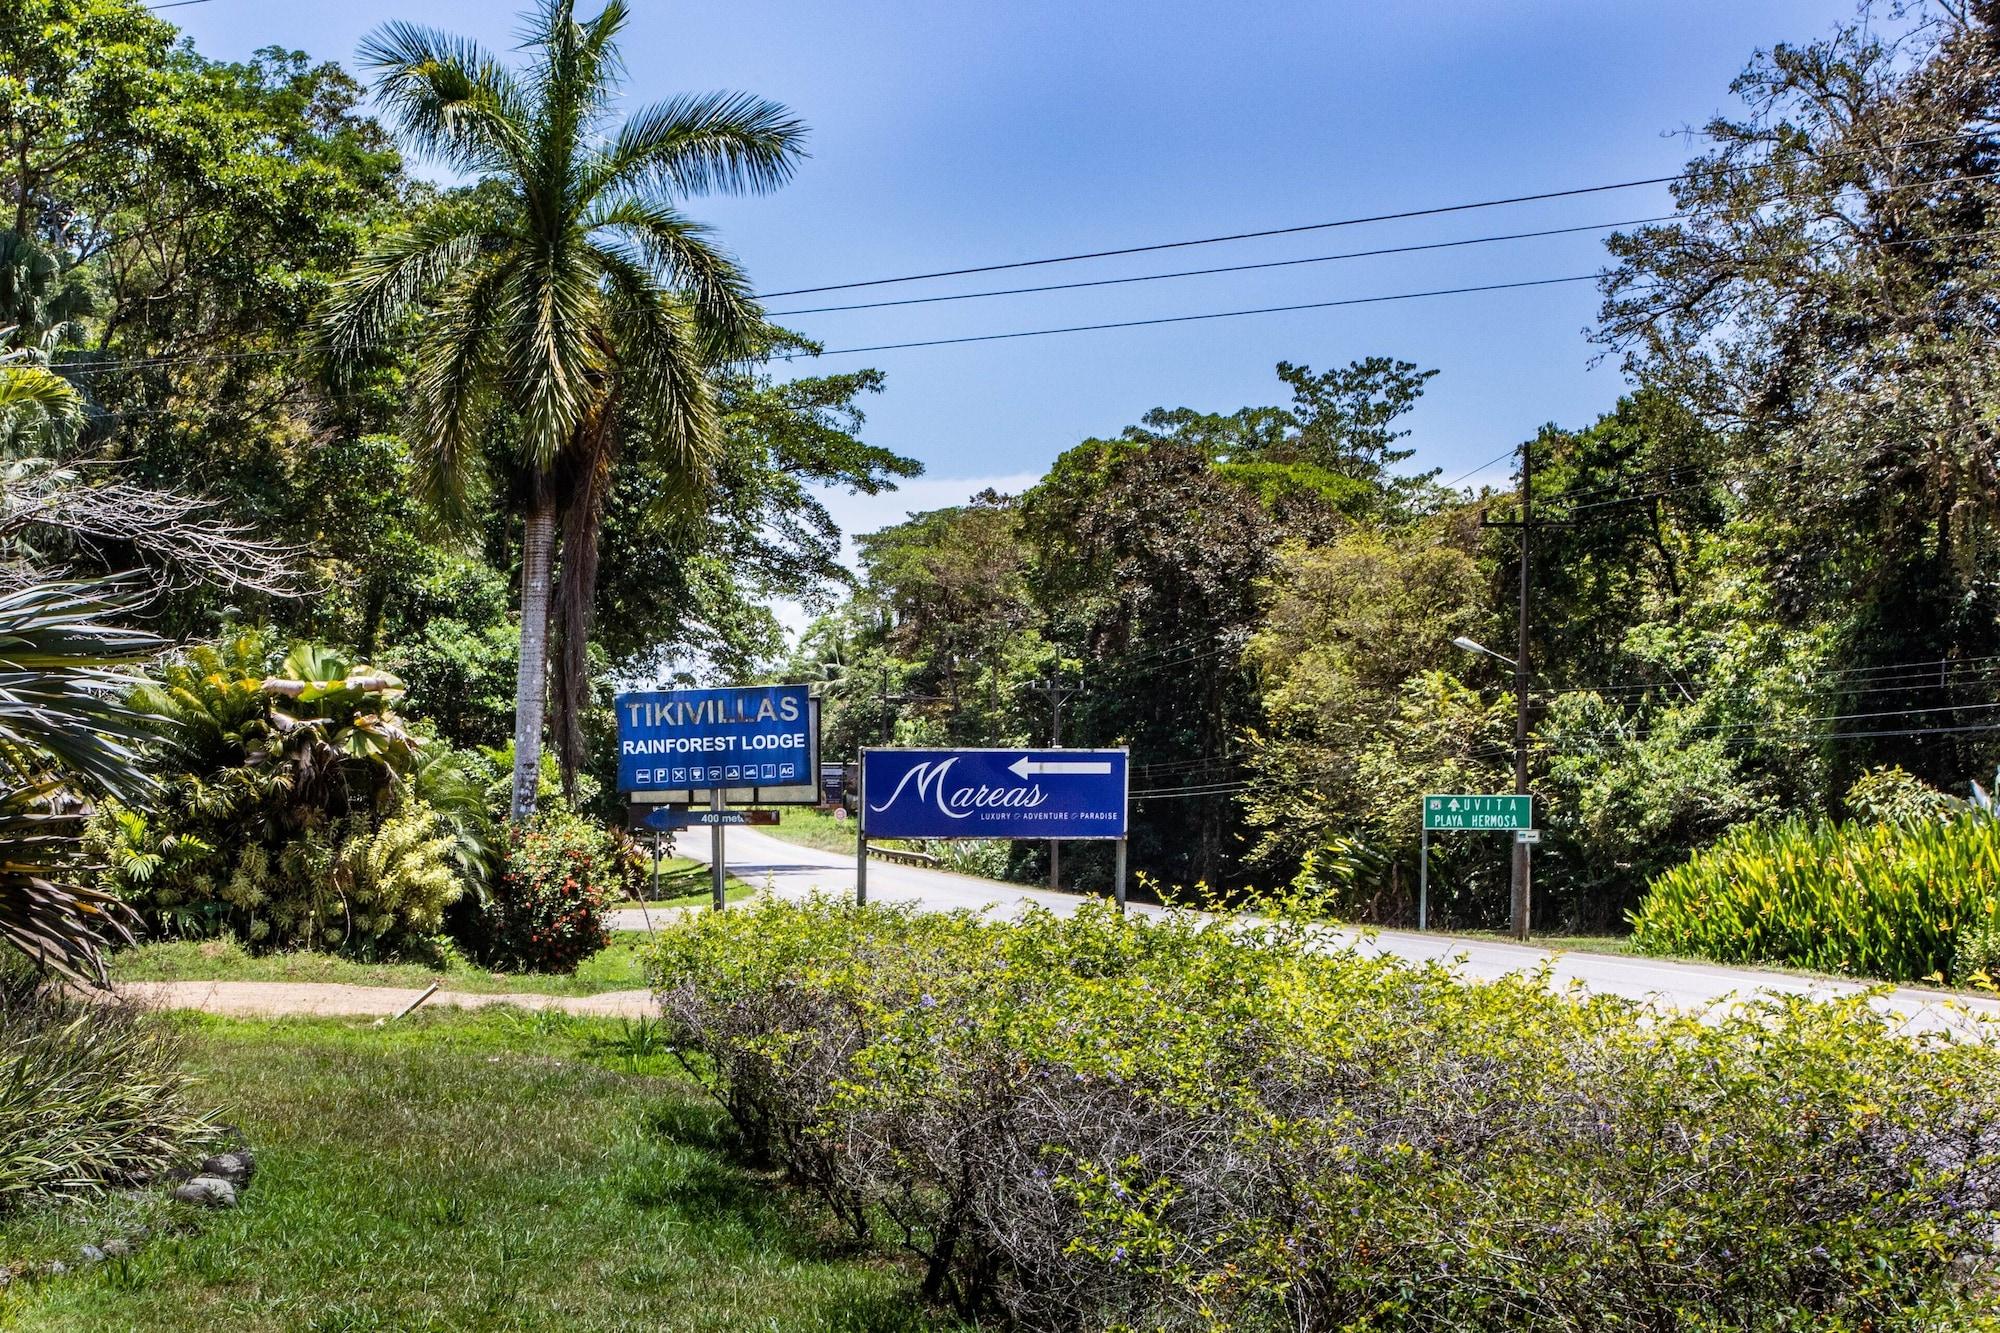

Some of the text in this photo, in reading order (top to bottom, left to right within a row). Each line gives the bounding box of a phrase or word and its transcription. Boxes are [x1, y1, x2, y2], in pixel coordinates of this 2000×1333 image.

[625, 696, 800, 728] TIKIVILLAS
[622, 733, 805, 756] RAINFOREST LODGE
[869, 756, 1049, 819] Mareas
[1463, 798, 1517, 811] UVITA
[701, 813, 745, 823] 400 met
[980, 812, 1118, 821] LUXURY ADVENTURE PARADISE
[1434, 814, 1518, 828] PLAYA HERMOSA
